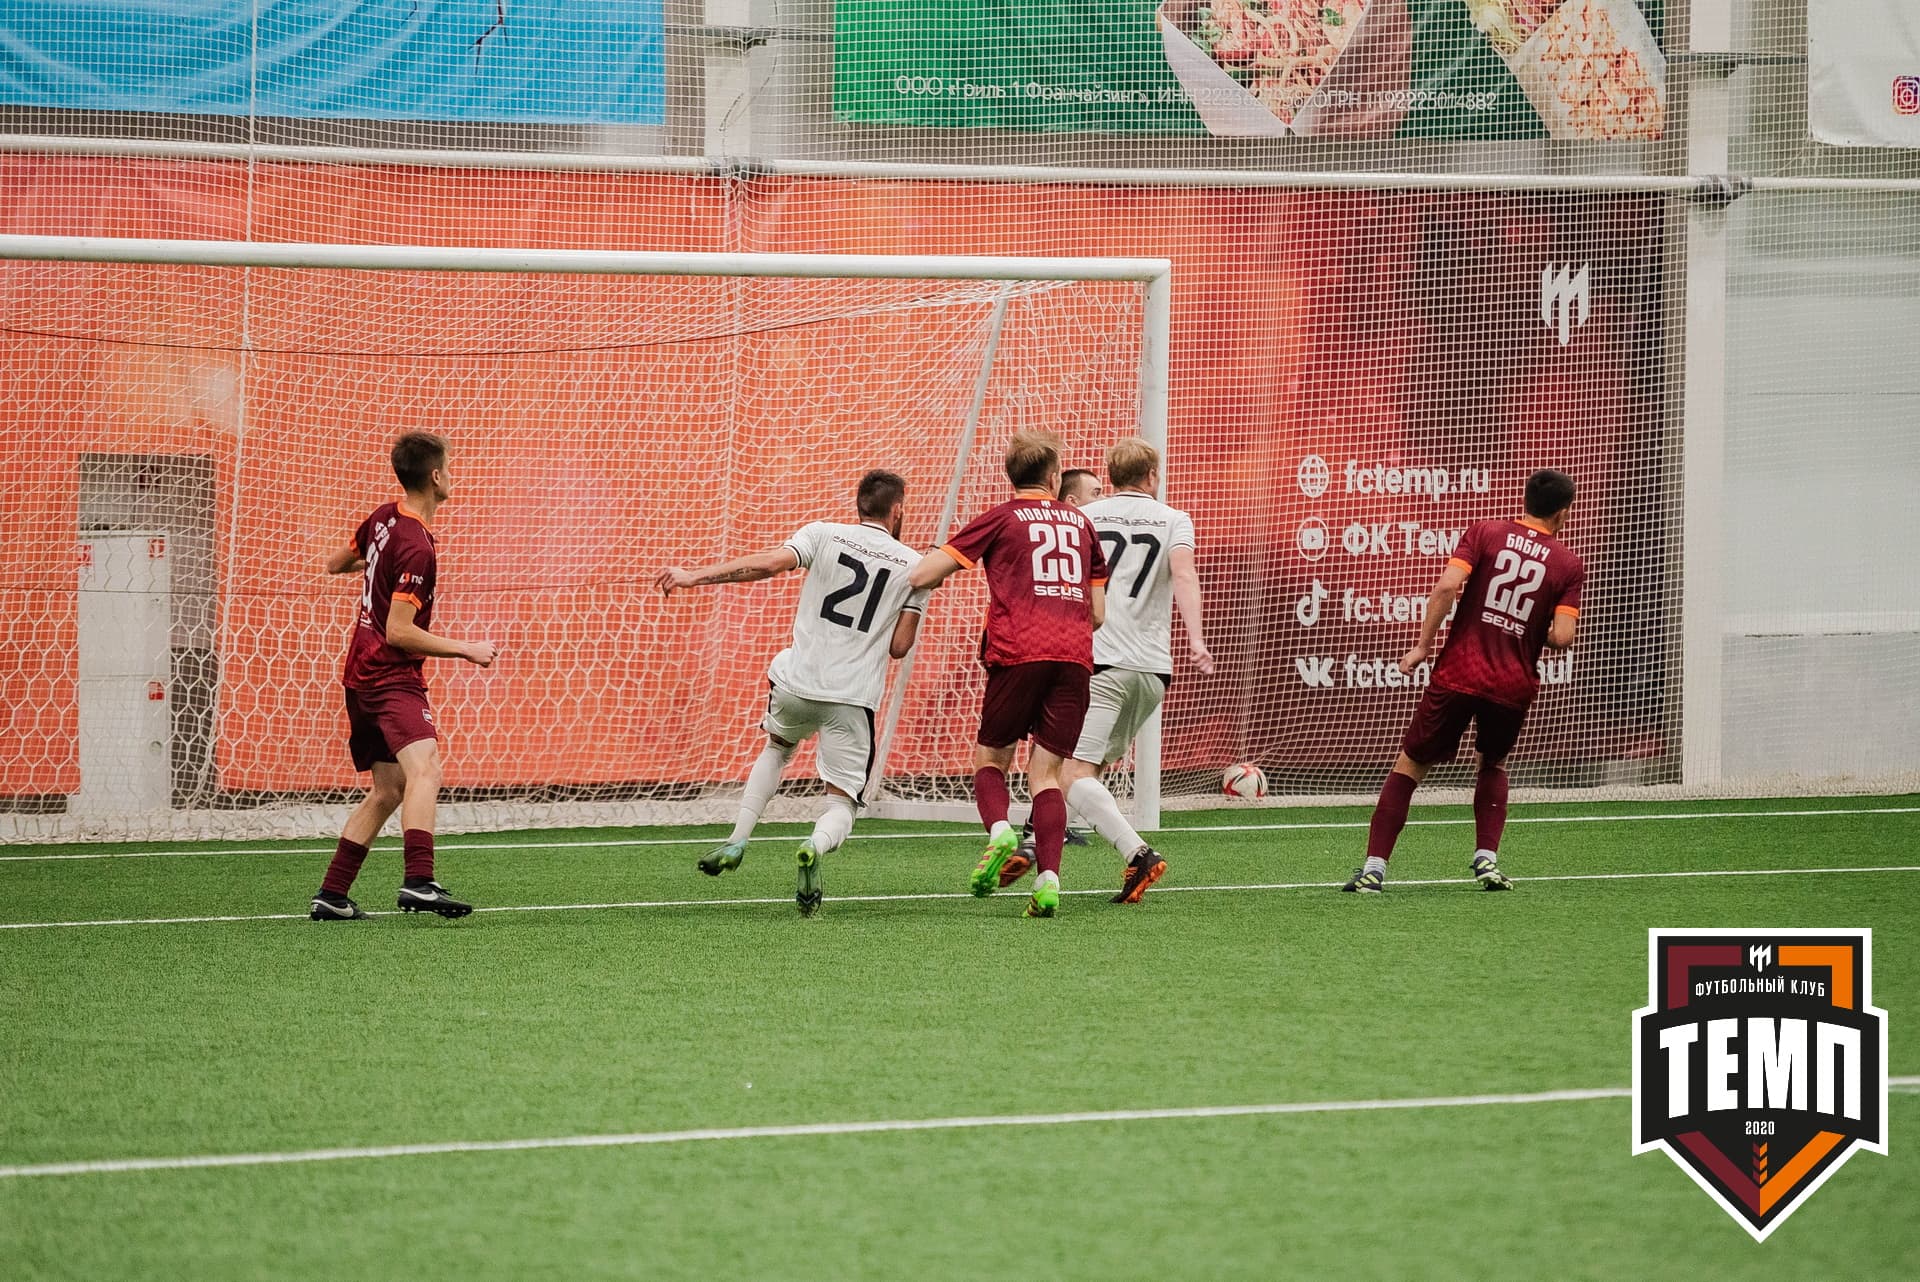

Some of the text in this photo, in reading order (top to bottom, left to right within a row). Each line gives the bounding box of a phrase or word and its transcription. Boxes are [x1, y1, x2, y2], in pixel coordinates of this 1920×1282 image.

[896, 75, 943, 95] ООО
[1344, 459, 1489, 502] fctemp.ru
[1013, 507, 1085, 530] НОВИЧКОВ
[1028, 522, 1082, 585] 25
[1343, 521, 1466, 556] ФК Тем
[1506, 533, 1551, 562] БАБИЧ
[1096, 530, 1161, 598] 77
[820, 551, 891, 634] 21
[1033, 583, 1083, 599] SEUS
[1484, 549, 1546, 622] 22
[1481, 611, 1526, 636] SEUS
